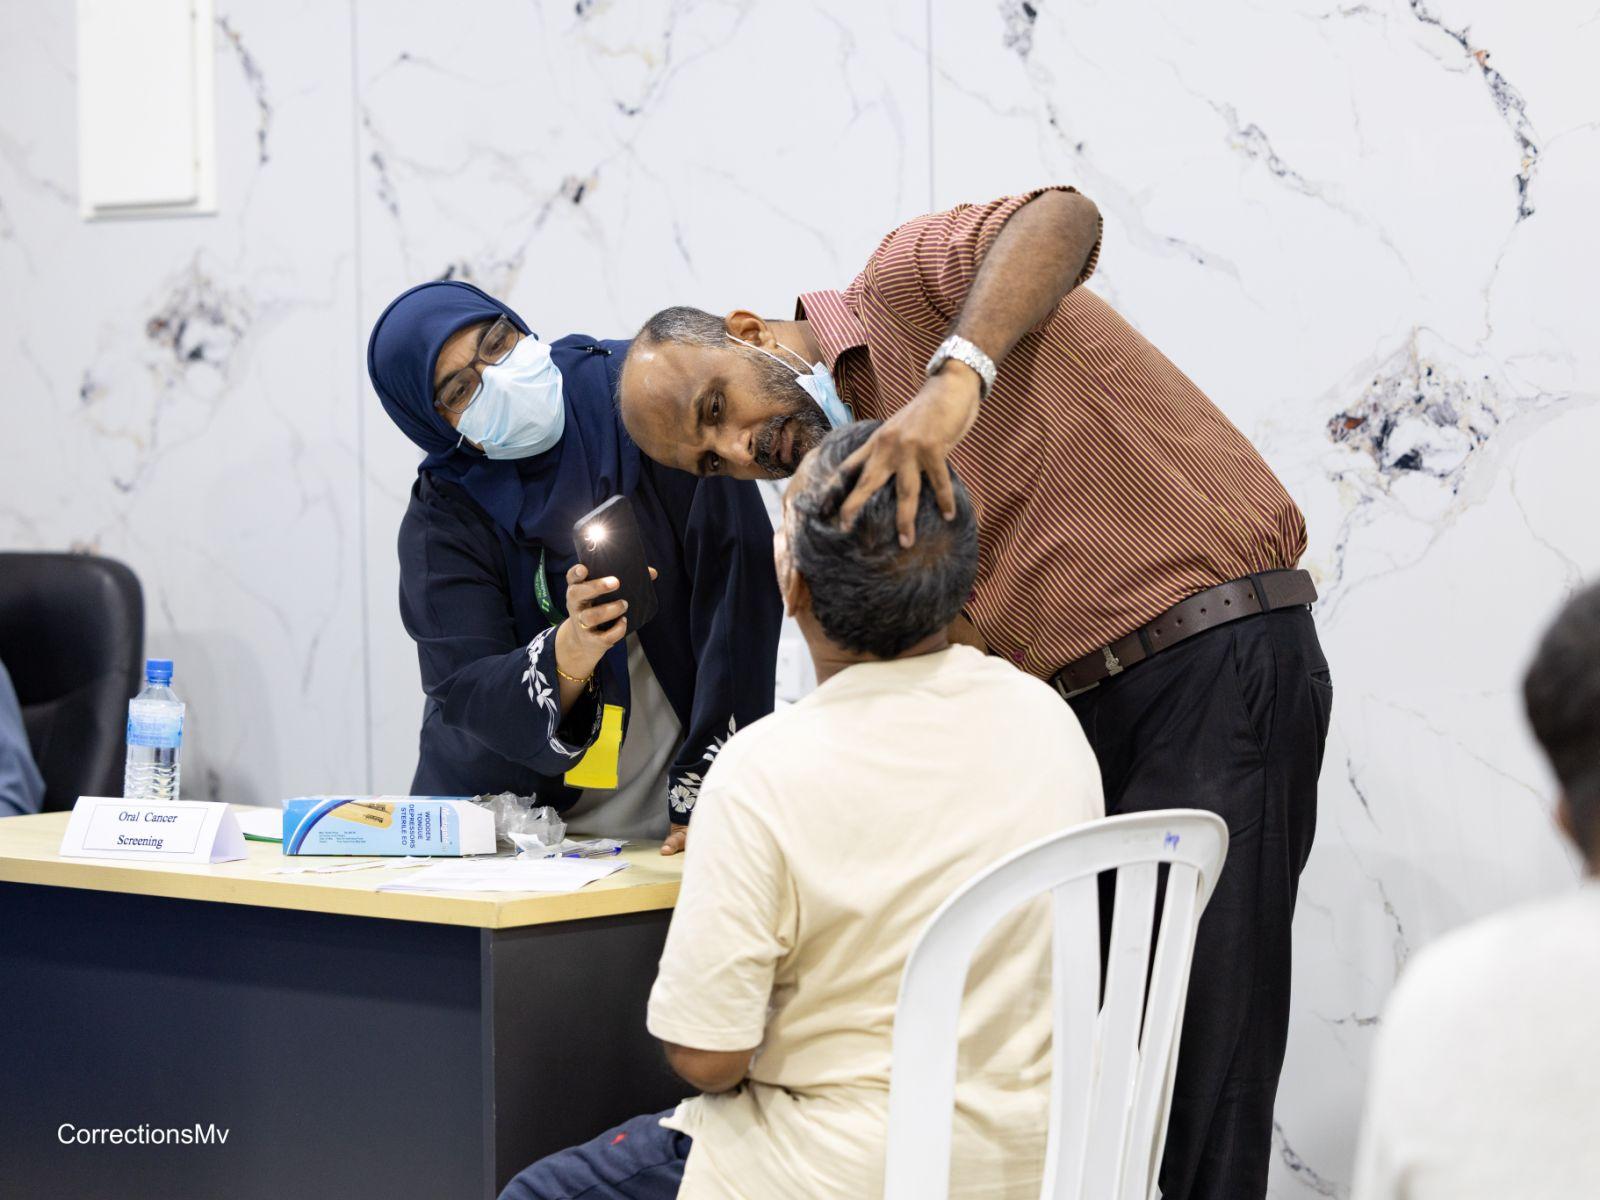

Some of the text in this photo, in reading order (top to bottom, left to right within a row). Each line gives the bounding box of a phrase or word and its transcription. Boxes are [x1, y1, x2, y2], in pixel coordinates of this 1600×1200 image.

[118, 811, 178, 823] Oral Cancer
[117, 834, 164, 849] Screening
